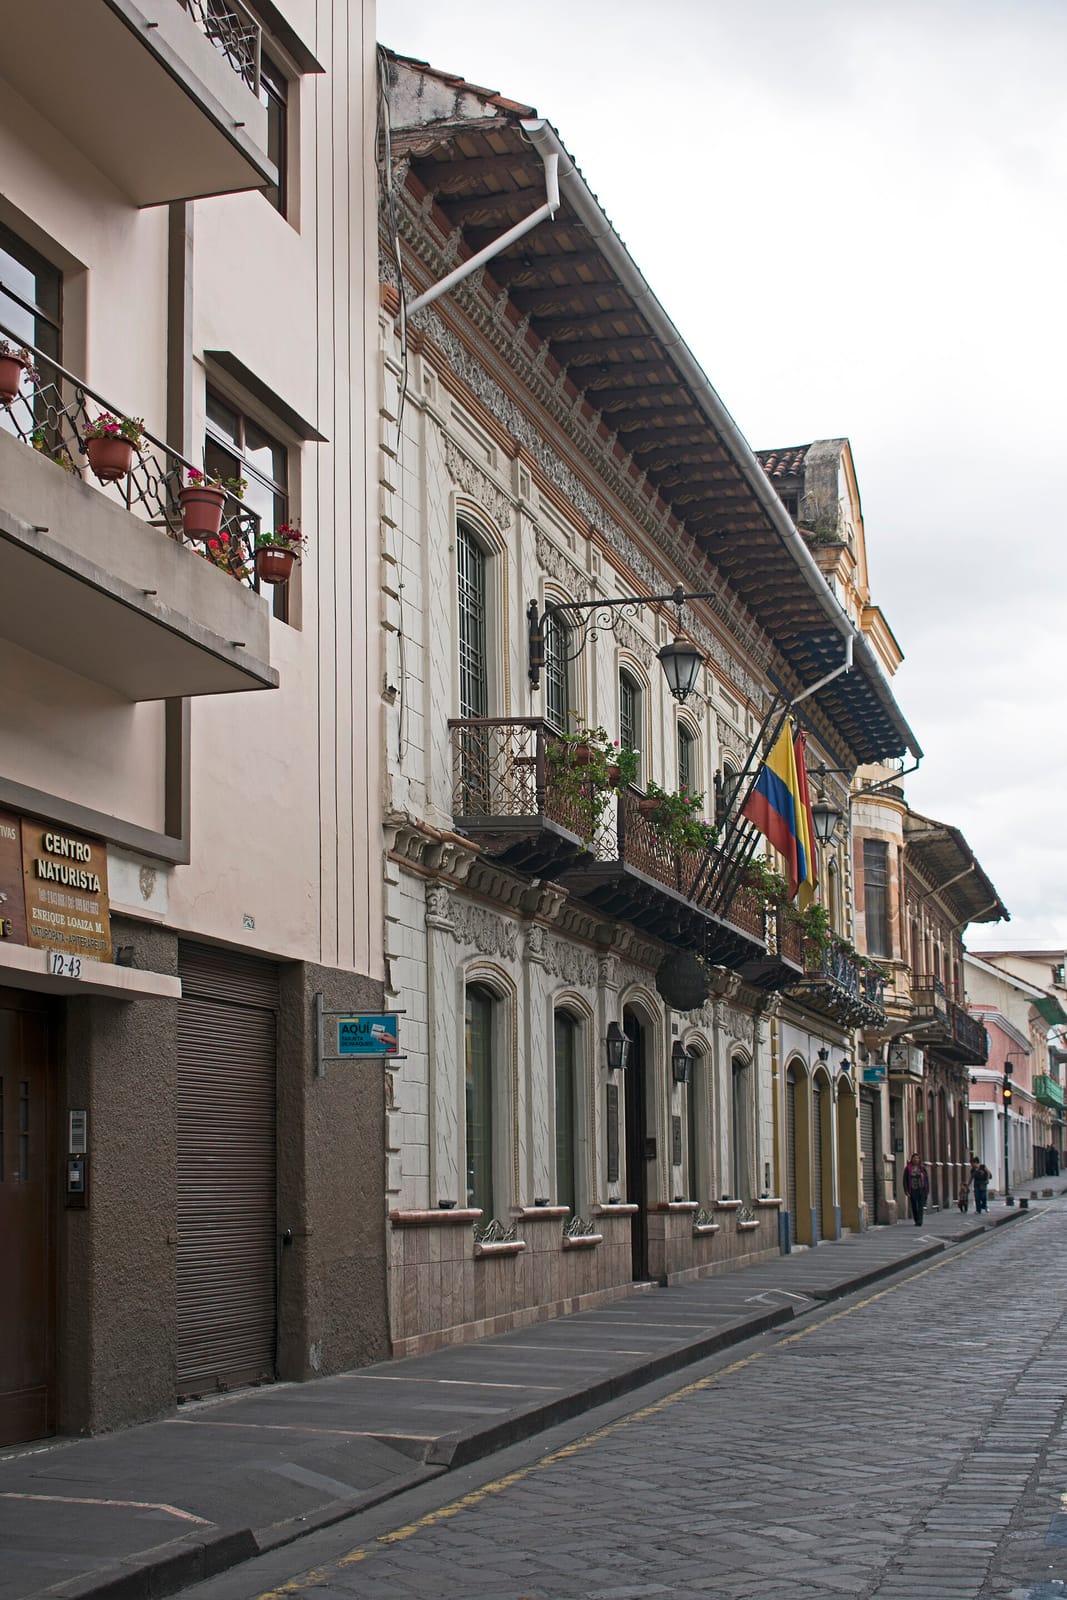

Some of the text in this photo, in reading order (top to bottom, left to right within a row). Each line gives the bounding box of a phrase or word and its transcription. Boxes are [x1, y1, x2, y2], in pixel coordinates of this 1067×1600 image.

[45, 833, 91, 862] CENTRO
[38, 859, 101, 892] NATURISTA
[32, 908, 105, 934] ENRIQUE LOAIZA M.
[32, 925, 64, 943] NATUROPATA
[52, 954, 81, 977] 12-43
[342, 1022, 370, 1035] AQUÍ
